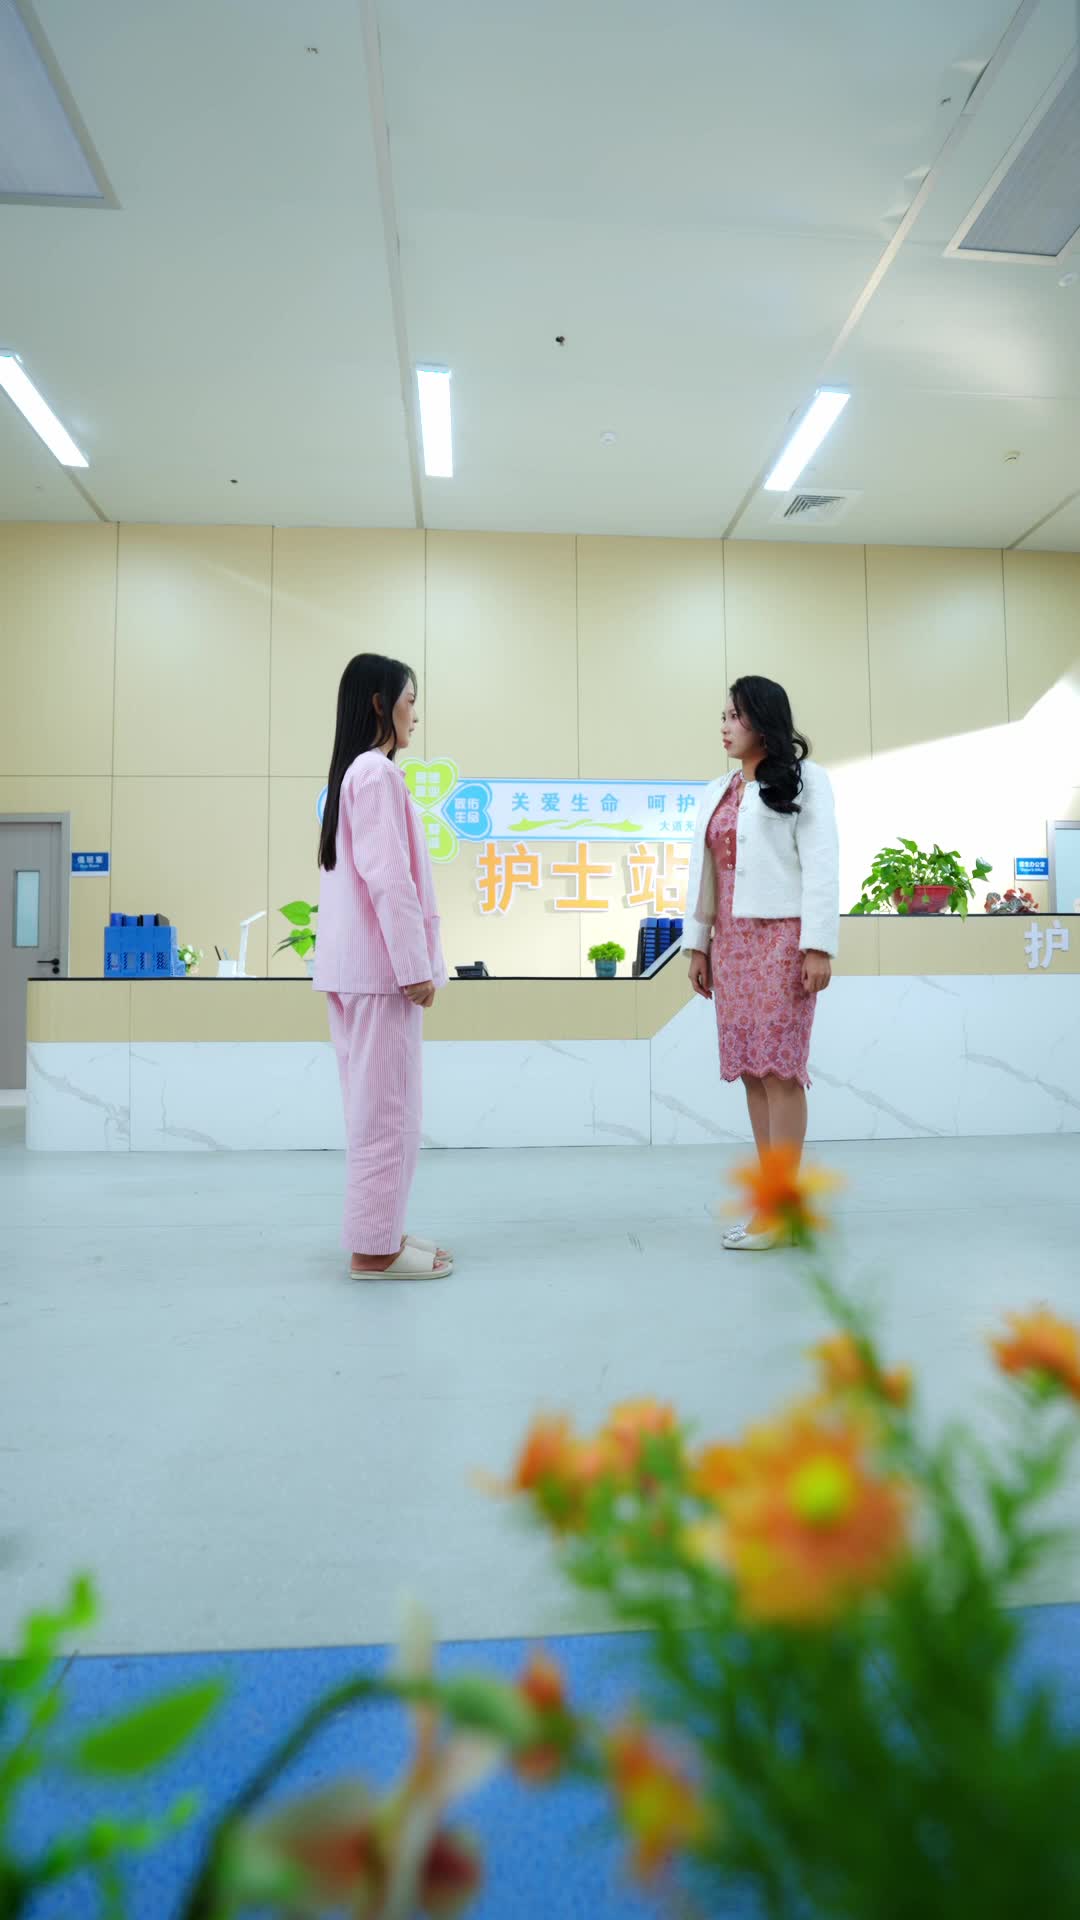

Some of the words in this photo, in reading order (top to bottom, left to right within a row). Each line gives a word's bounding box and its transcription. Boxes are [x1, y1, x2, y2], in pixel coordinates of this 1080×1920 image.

[511, 792, 619, 813] 关爱生命
[647, 793, 695, 813] 呵护
[478, 841, 690, 913] 护士站
[1023, 919, 1070, 970] 护
